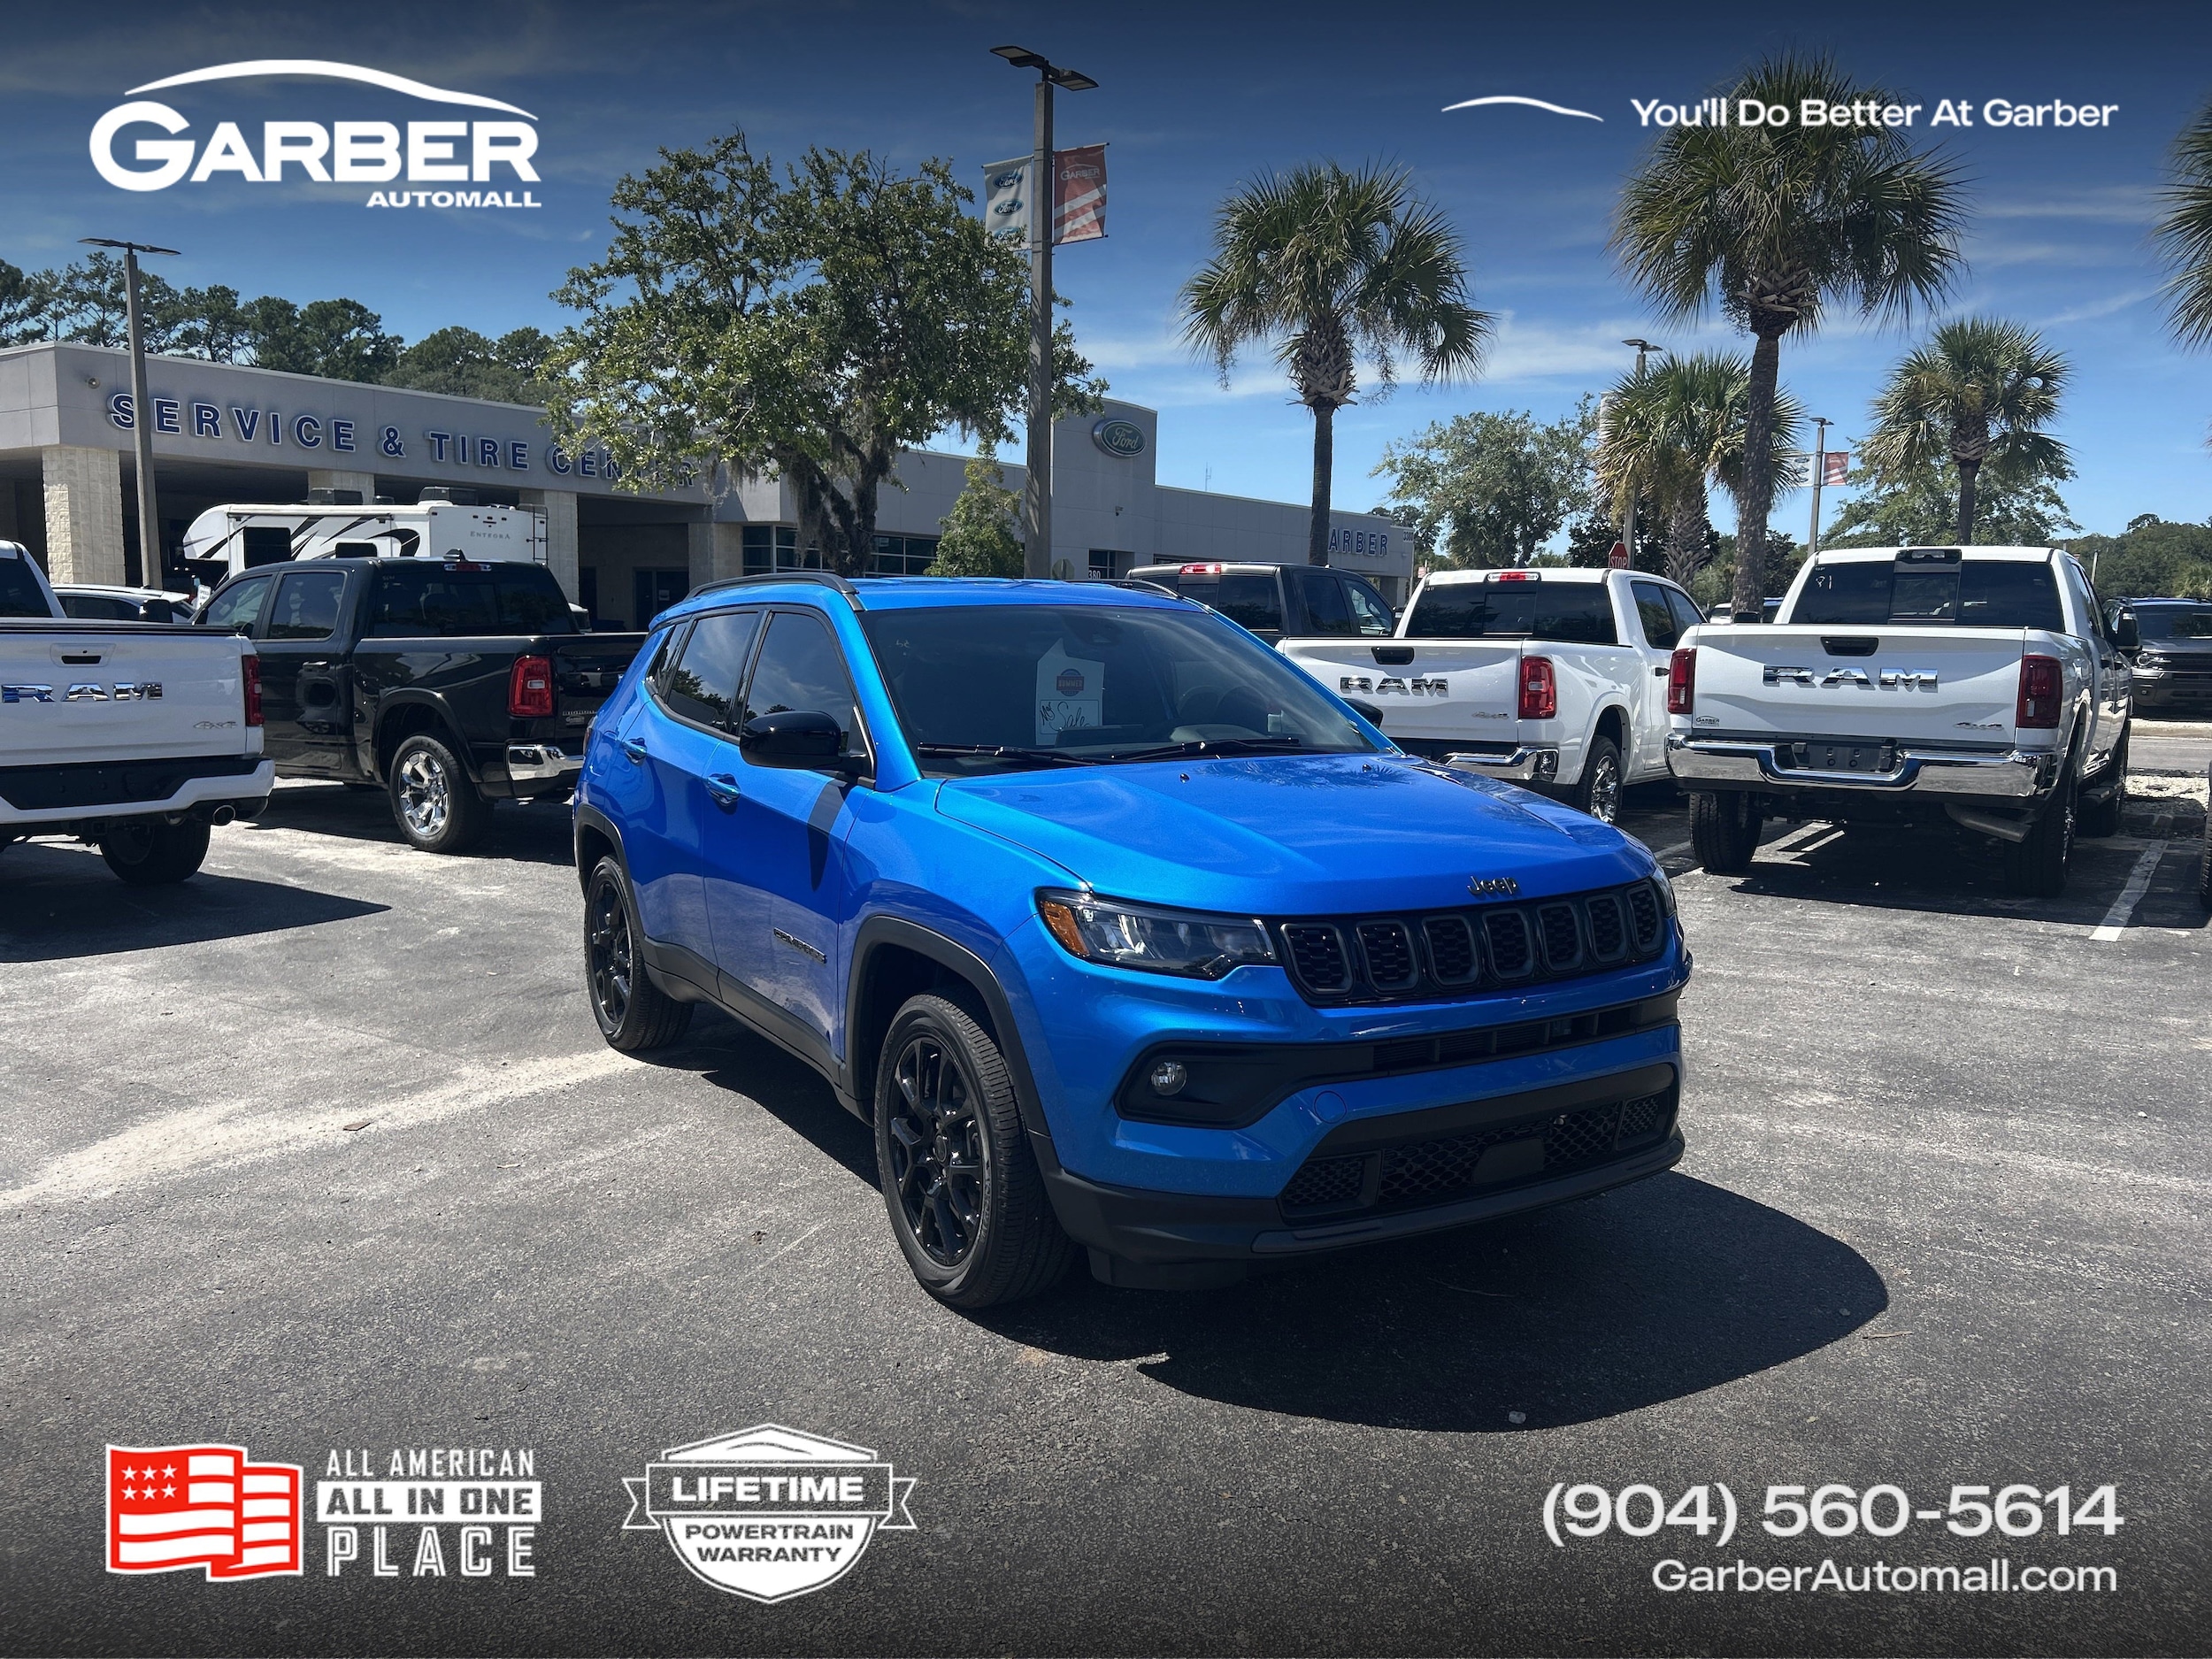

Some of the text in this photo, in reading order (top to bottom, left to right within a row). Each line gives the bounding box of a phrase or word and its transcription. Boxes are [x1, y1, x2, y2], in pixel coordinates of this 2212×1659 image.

[1060, 167, 1101, 181] GARBER
[111, 393, 356, 453] SERVICE
[381, 426, 407, 458] &
[428, 430, 529, 471] TIRE
[1111, 426, 1140, 449] Ford
[1328, 527, 1388, 557] ARBER
[1610, 556, 1627, 569] STOP
[1340, 676, 1449, 697] RAM
[1763, 664, 1939, 692] RAM
[1, 682, 163, 703] RAM
[1466, 875, 1517, 895] Jeep
